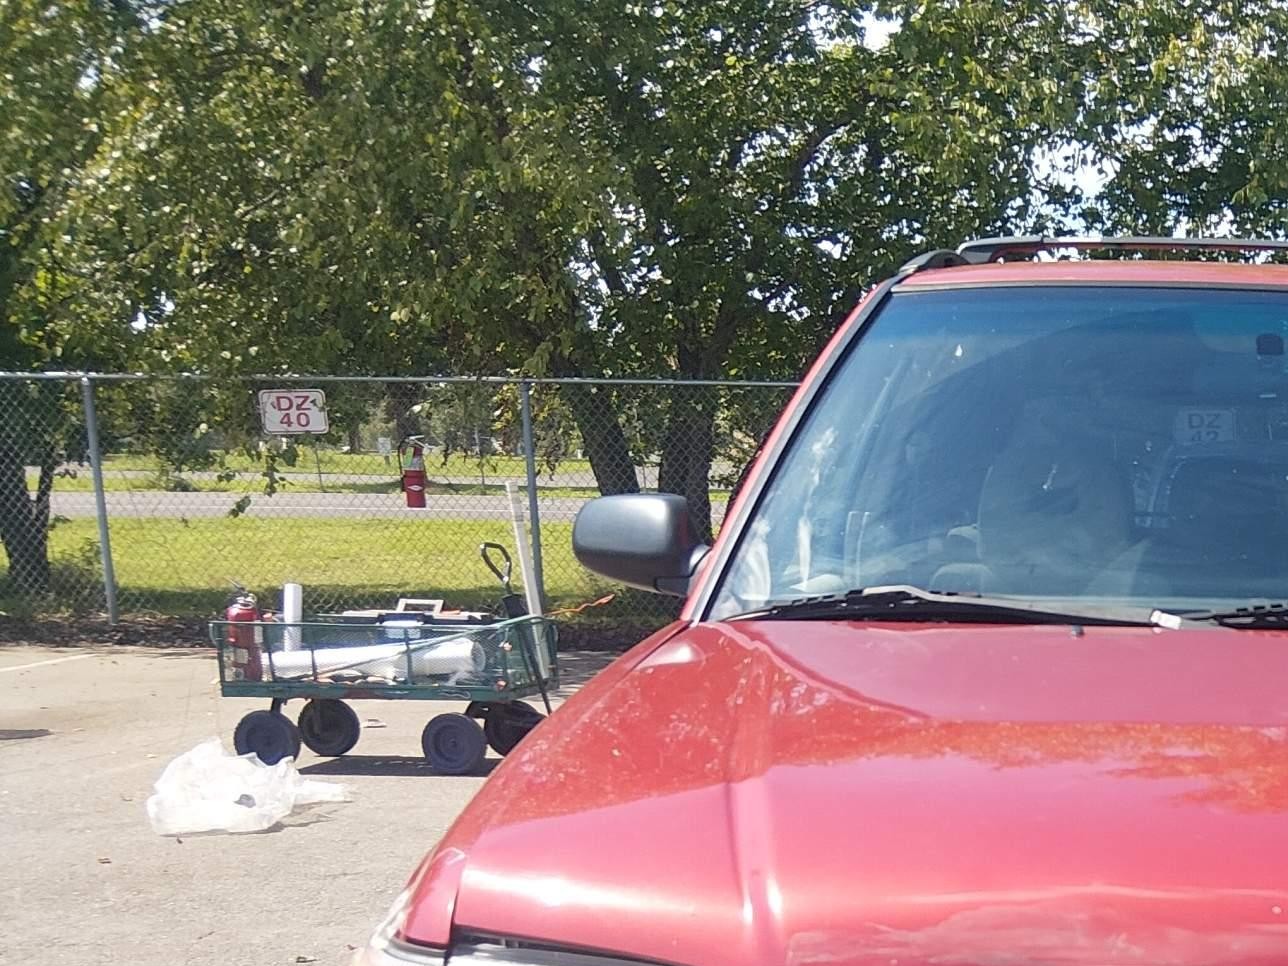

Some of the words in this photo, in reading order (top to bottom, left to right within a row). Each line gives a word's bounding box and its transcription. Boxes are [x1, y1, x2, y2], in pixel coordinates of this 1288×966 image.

[275, 395, 312, 412] DZ
[279, 412, 311, 428] 40
[1187, 412, 1222, 430] DZ
